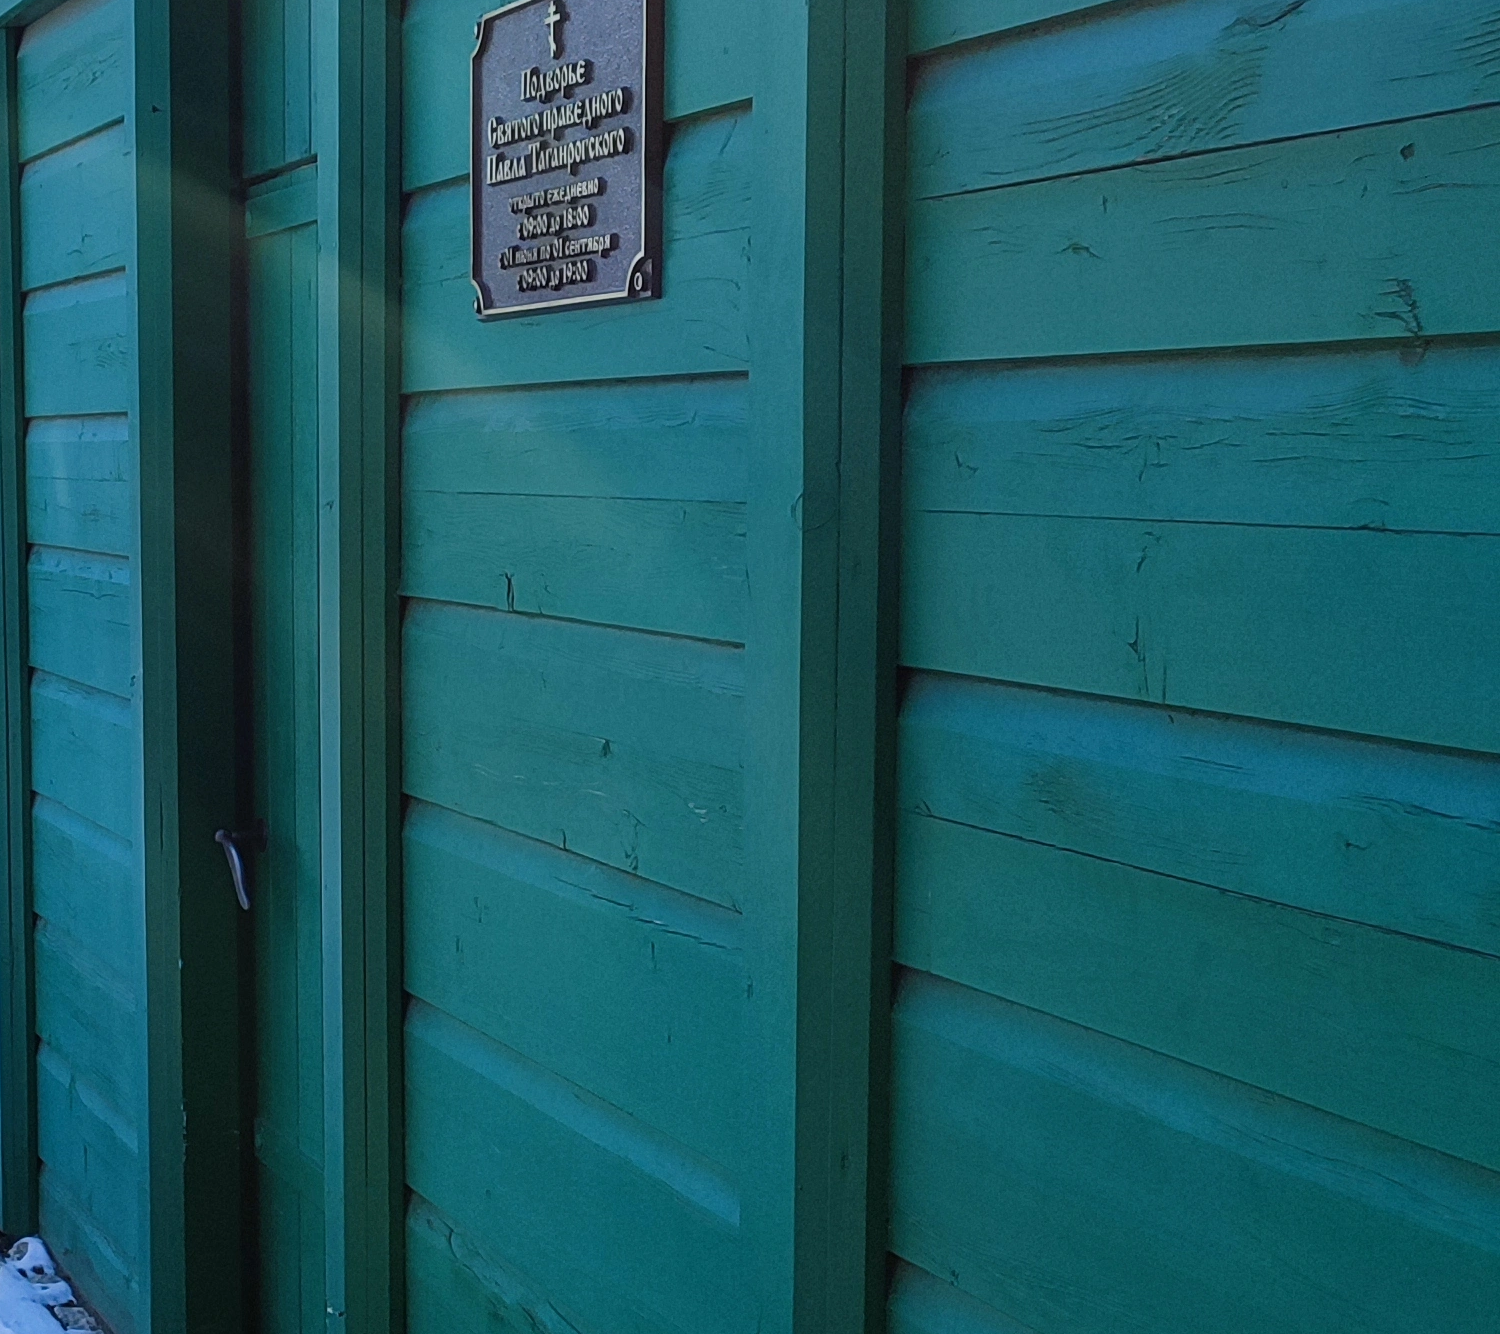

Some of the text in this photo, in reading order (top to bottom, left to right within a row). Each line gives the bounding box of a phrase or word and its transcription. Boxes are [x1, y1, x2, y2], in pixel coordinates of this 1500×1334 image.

[520, 59, 586, 101] Подворье
[487, 87, 623, 147] Святого праведного
[486, 127, 625, 184] Павла Таганрогского
[508, 177, 599, 214] открыто ежедневно
[522, 214, 547, 237] 09:00
[549, 215, 560, 235] до
[563, 204, 589, 228] 18:00
[539, 244, 551, 260] по
[552, 238, 563, 257] 01
[565, 234, 611, 257] сентября
[522, 266, 547, 289] 09:00
[548, 269, 559, 287] до
[562, 260, 588, 284] 19:00
